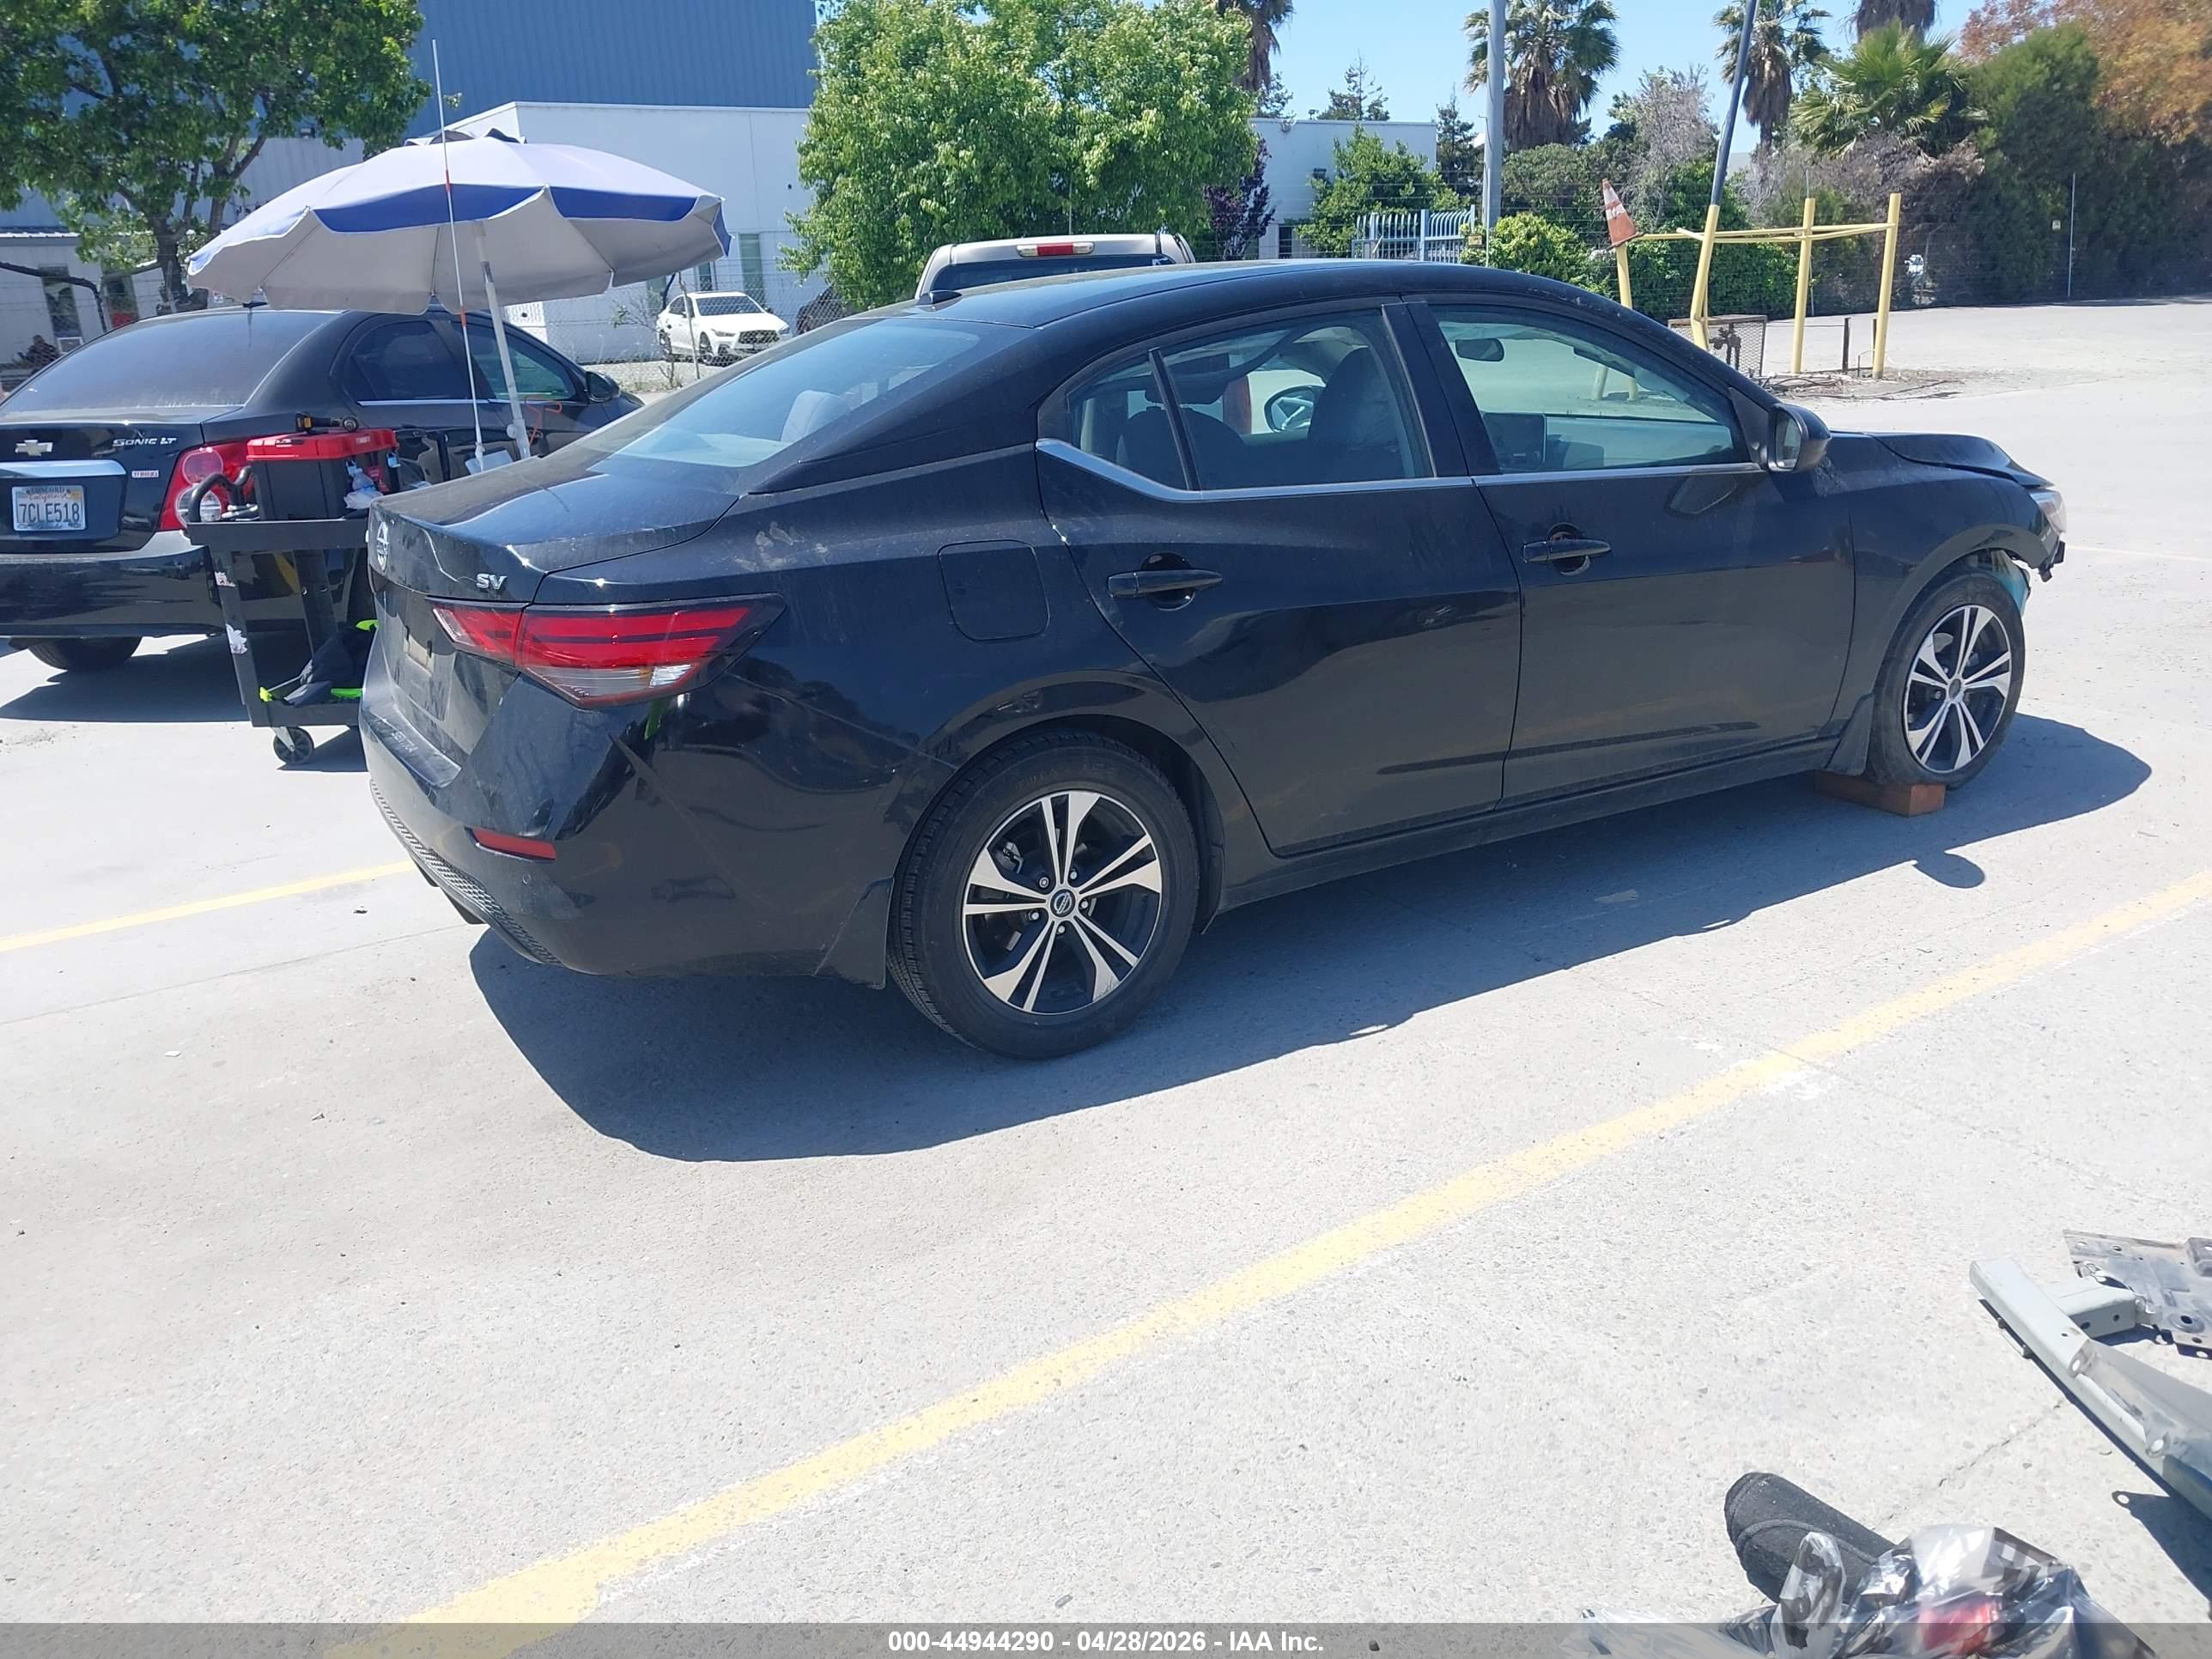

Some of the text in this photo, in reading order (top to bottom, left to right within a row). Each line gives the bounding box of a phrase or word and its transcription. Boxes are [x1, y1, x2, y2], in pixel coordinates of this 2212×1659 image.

[112, 438, 157, 447] SONIC
[18, 502, 80, 523] 7CLE518
[476, 573, 507, 590] SV
